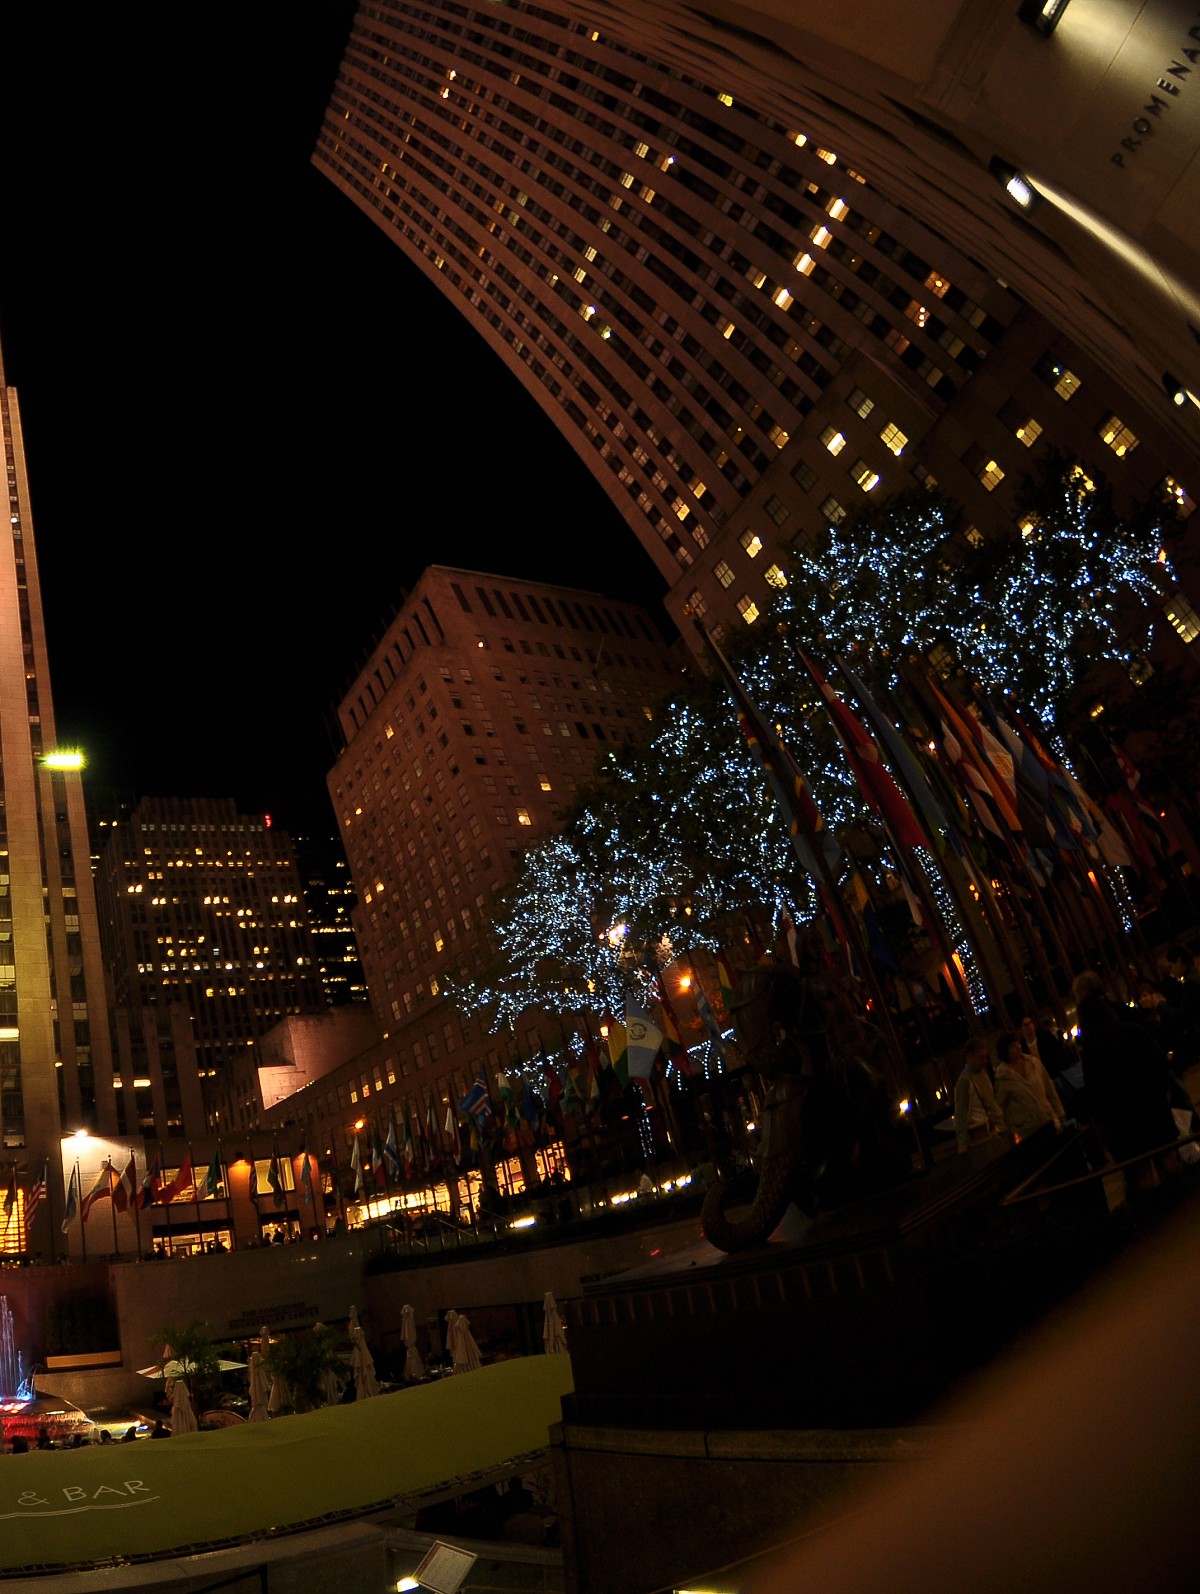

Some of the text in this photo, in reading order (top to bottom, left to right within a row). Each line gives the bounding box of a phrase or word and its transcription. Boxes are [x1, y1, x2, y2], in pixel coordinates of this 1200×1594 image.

[1111, 10, 1200, 169] PROMENA
[289, 1309, 319, 1320] CENTER
[17, 1490, 50, 1506] &
[62, 1479, 150, 1502] BAR
